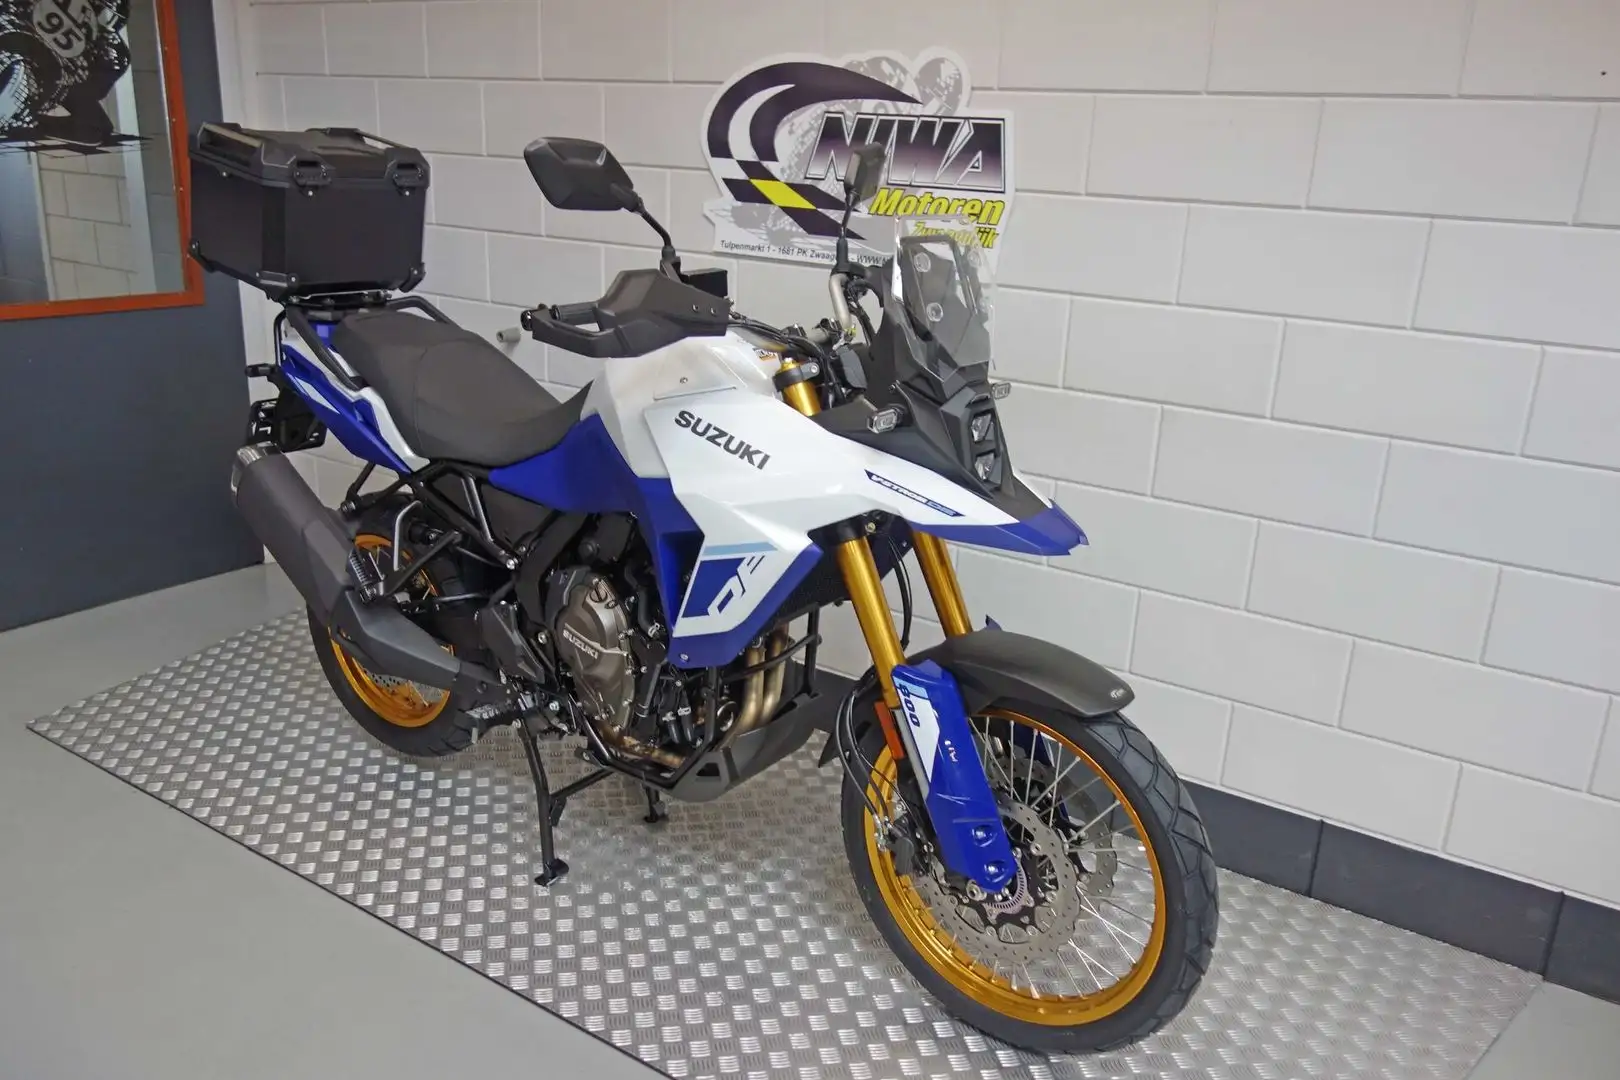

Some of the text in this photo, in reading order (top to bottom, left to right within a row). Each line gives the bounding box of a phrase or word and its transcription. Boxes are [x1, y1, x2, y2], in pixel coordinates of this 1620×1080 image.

[38, 12, 83, 50] 95
[868, 187, 1005, 226] Motoren
[720, 240, 765, 253] Tulpenmarkt
[796, 248, 808, 257] PK
[674, 410, 771, 470] SUZUKI
[563, 629, 599, 660] SUZUKI
[899, 683, 921, 728] 800
